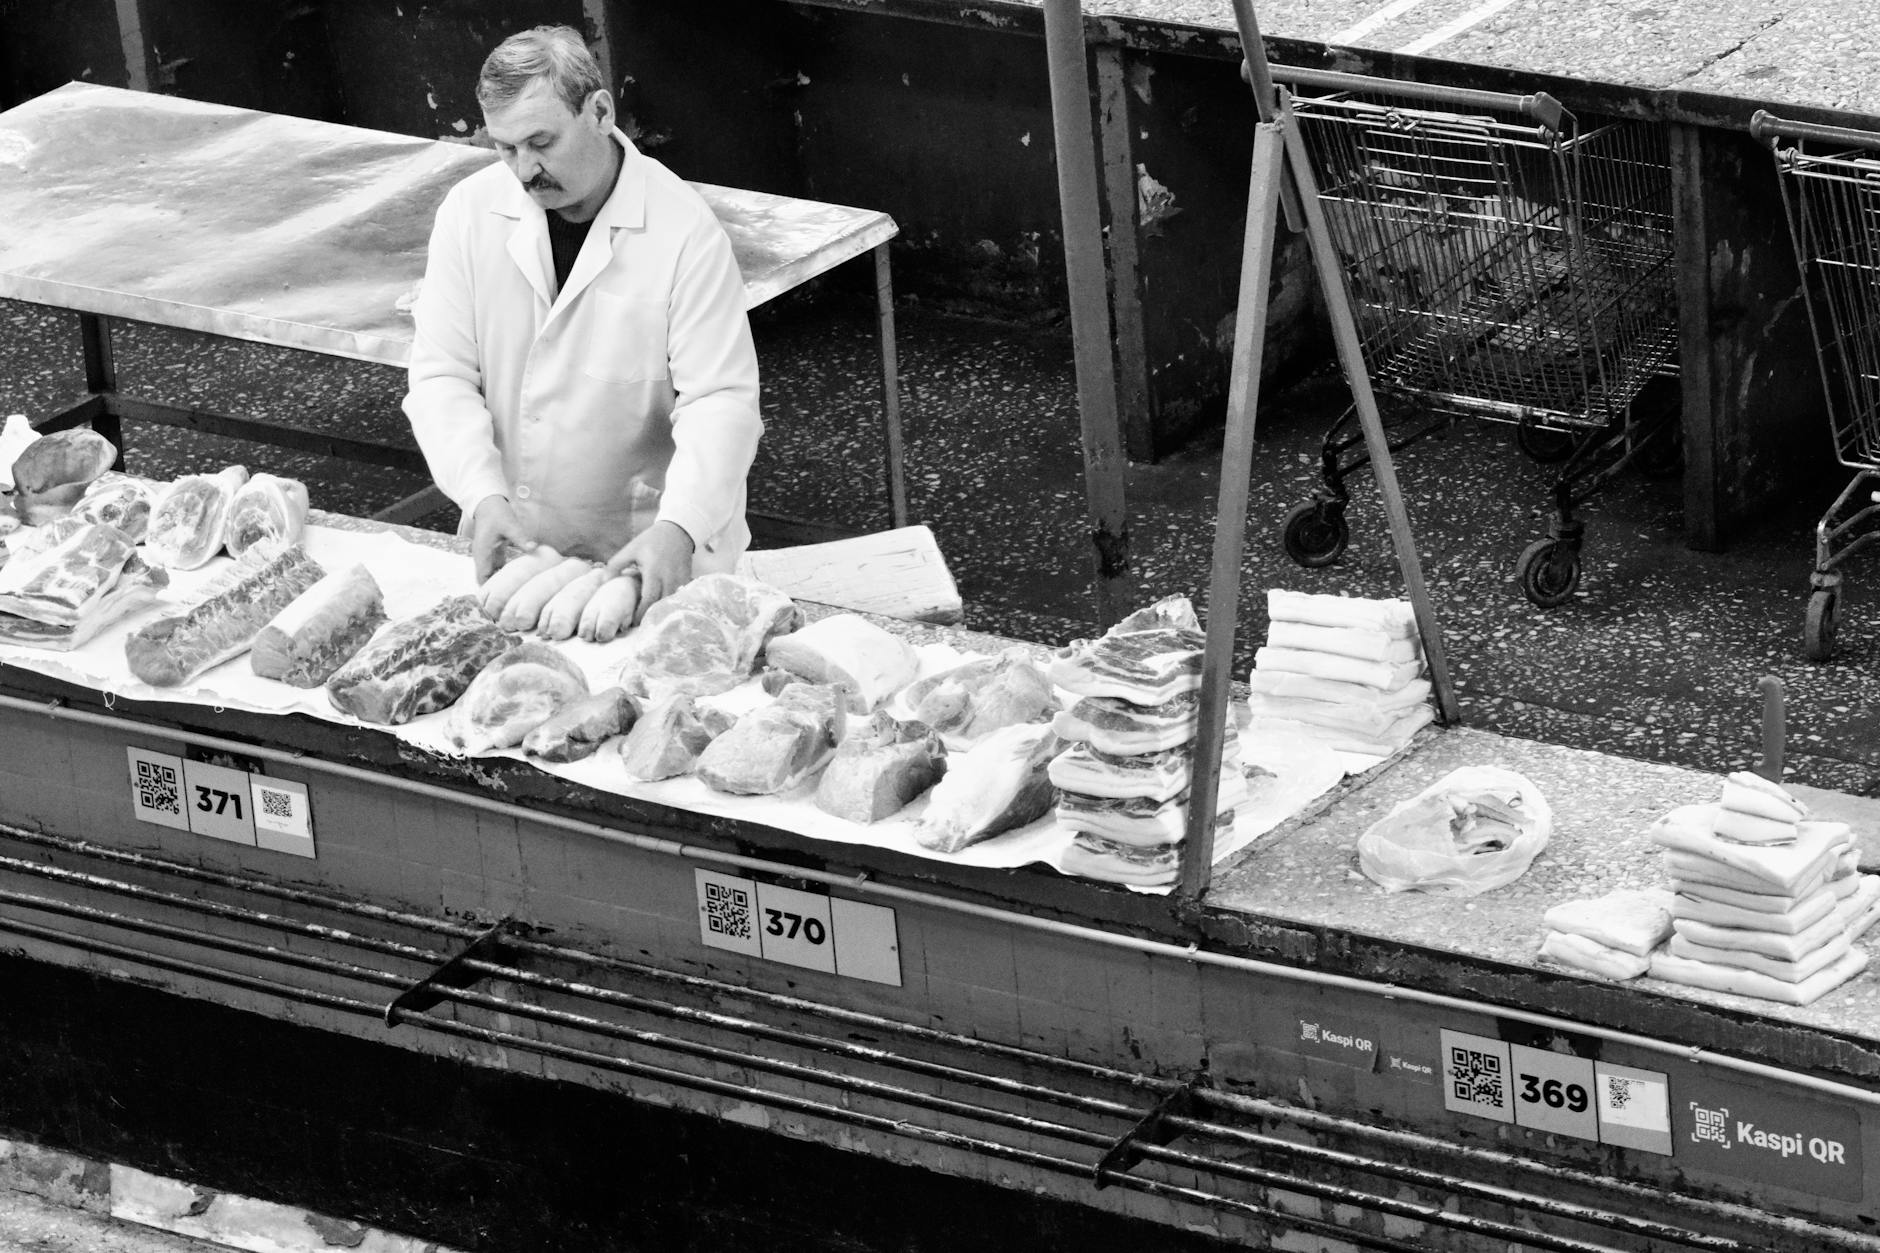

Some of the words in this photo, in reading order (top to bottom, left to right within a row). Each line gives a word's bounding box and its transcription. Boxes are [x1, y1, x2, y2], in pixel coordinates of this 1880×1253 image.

[195, 785, 242, 820] 371
[765, 908, 826, 945] 370
[1322, 1030, 1353, 1048] Kaspi
[1355, 1038, 1372, 1051] QR
[1402, 1061, 1421, 1072] Kaspi
[1421, 1066, 1432, 1074] QR
[1520, 1073, 1588, 1113] 369
[1737, 1121, 1803, 1157] Kaspi
[1808, 1127, 1846, 1164] QR
